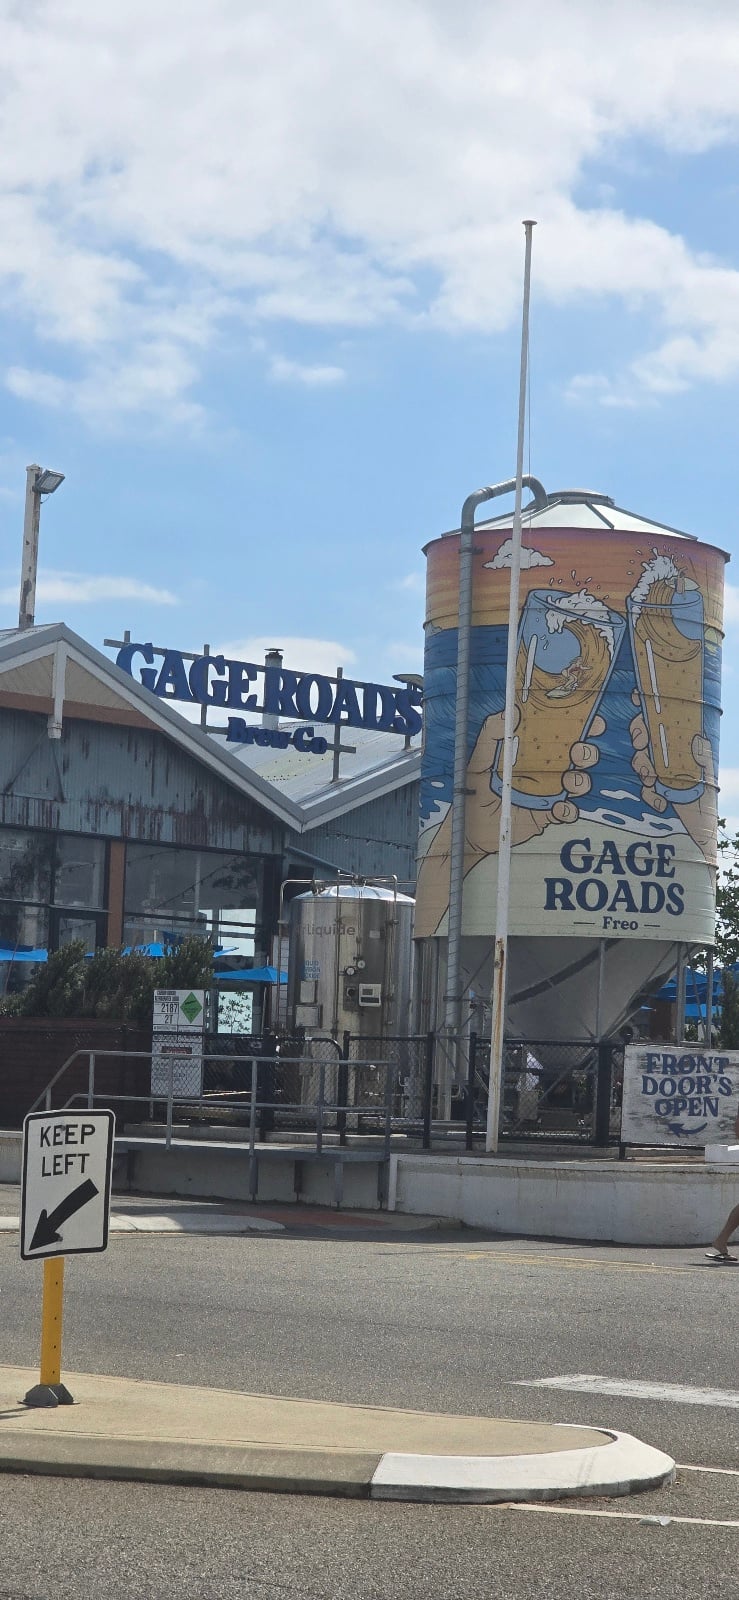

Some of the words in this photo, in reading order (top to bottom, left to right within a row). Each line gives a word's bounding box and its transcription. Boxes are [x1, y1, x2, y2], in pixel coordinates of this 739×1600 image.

[116, 643, 258, 710] GAGE
[263, 666, 422, 736] ROADS
[226, 716, 291, 749] Brew
[293, 726, 328, 754] Co
[560, 837, 676, 878] GAGE
[544, 877, 685, 916] ROADS
[602, 916, 639, 931] Freo
[161, 1003, 178, 1013] 2187
[646, 1053, 730, 1075] FRONT
[641, 1074, 733, 1097] DOOR'S
[654, 1096, 720, 1117] OPEN
[40, 1124, 96, 1147] KEEP
[41, 1153, 90, 1177] LEFT
